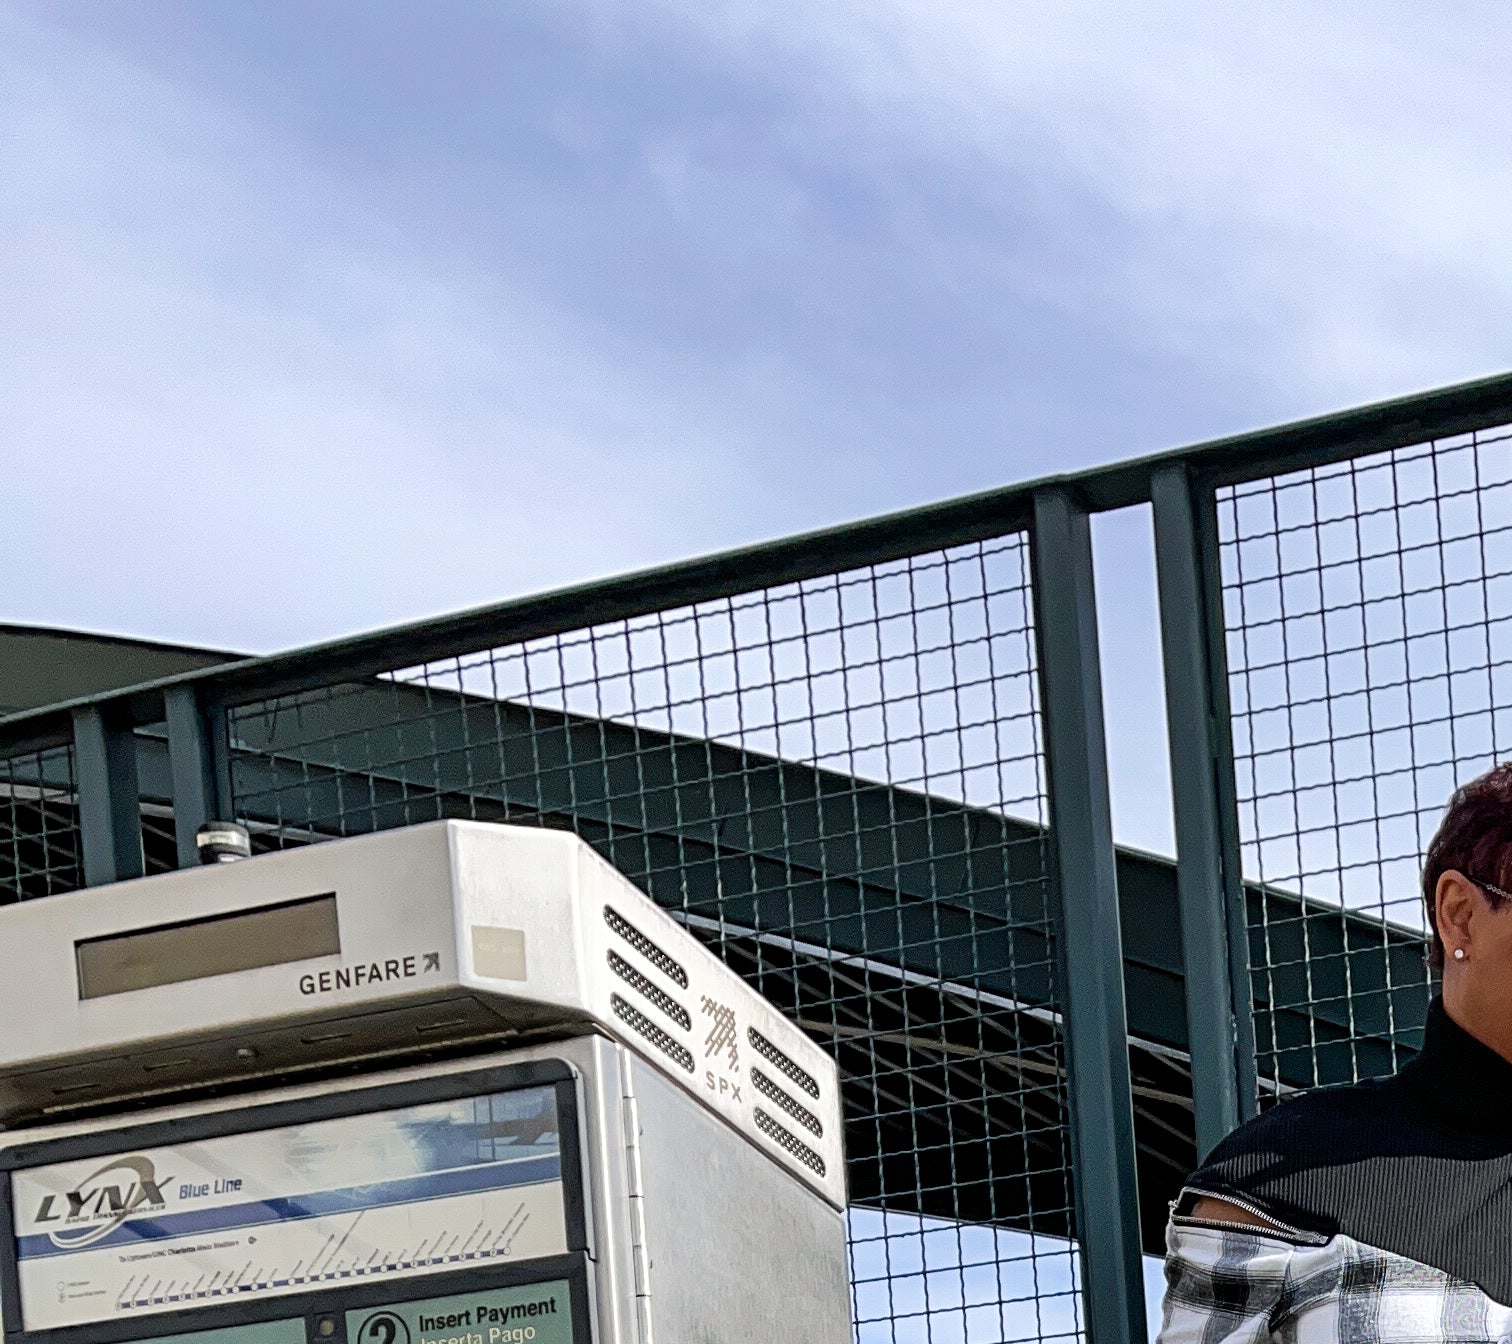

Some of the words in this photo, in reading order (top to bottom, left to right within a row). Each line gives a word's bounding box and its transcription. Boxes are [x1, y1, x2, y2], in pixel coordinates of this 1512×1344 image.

[299, 955, 417, 995] GENFARE
[705, 1071, 743, 1104] SPX
[34, 1175, 176, 1224] LYNX
[178, 1181, 210, 1201] Blue
[214, 1176, 243, 1195] Line
[419, 1308, 471, 1333] Insert
[476, 1296, 557, 1326] Payment
